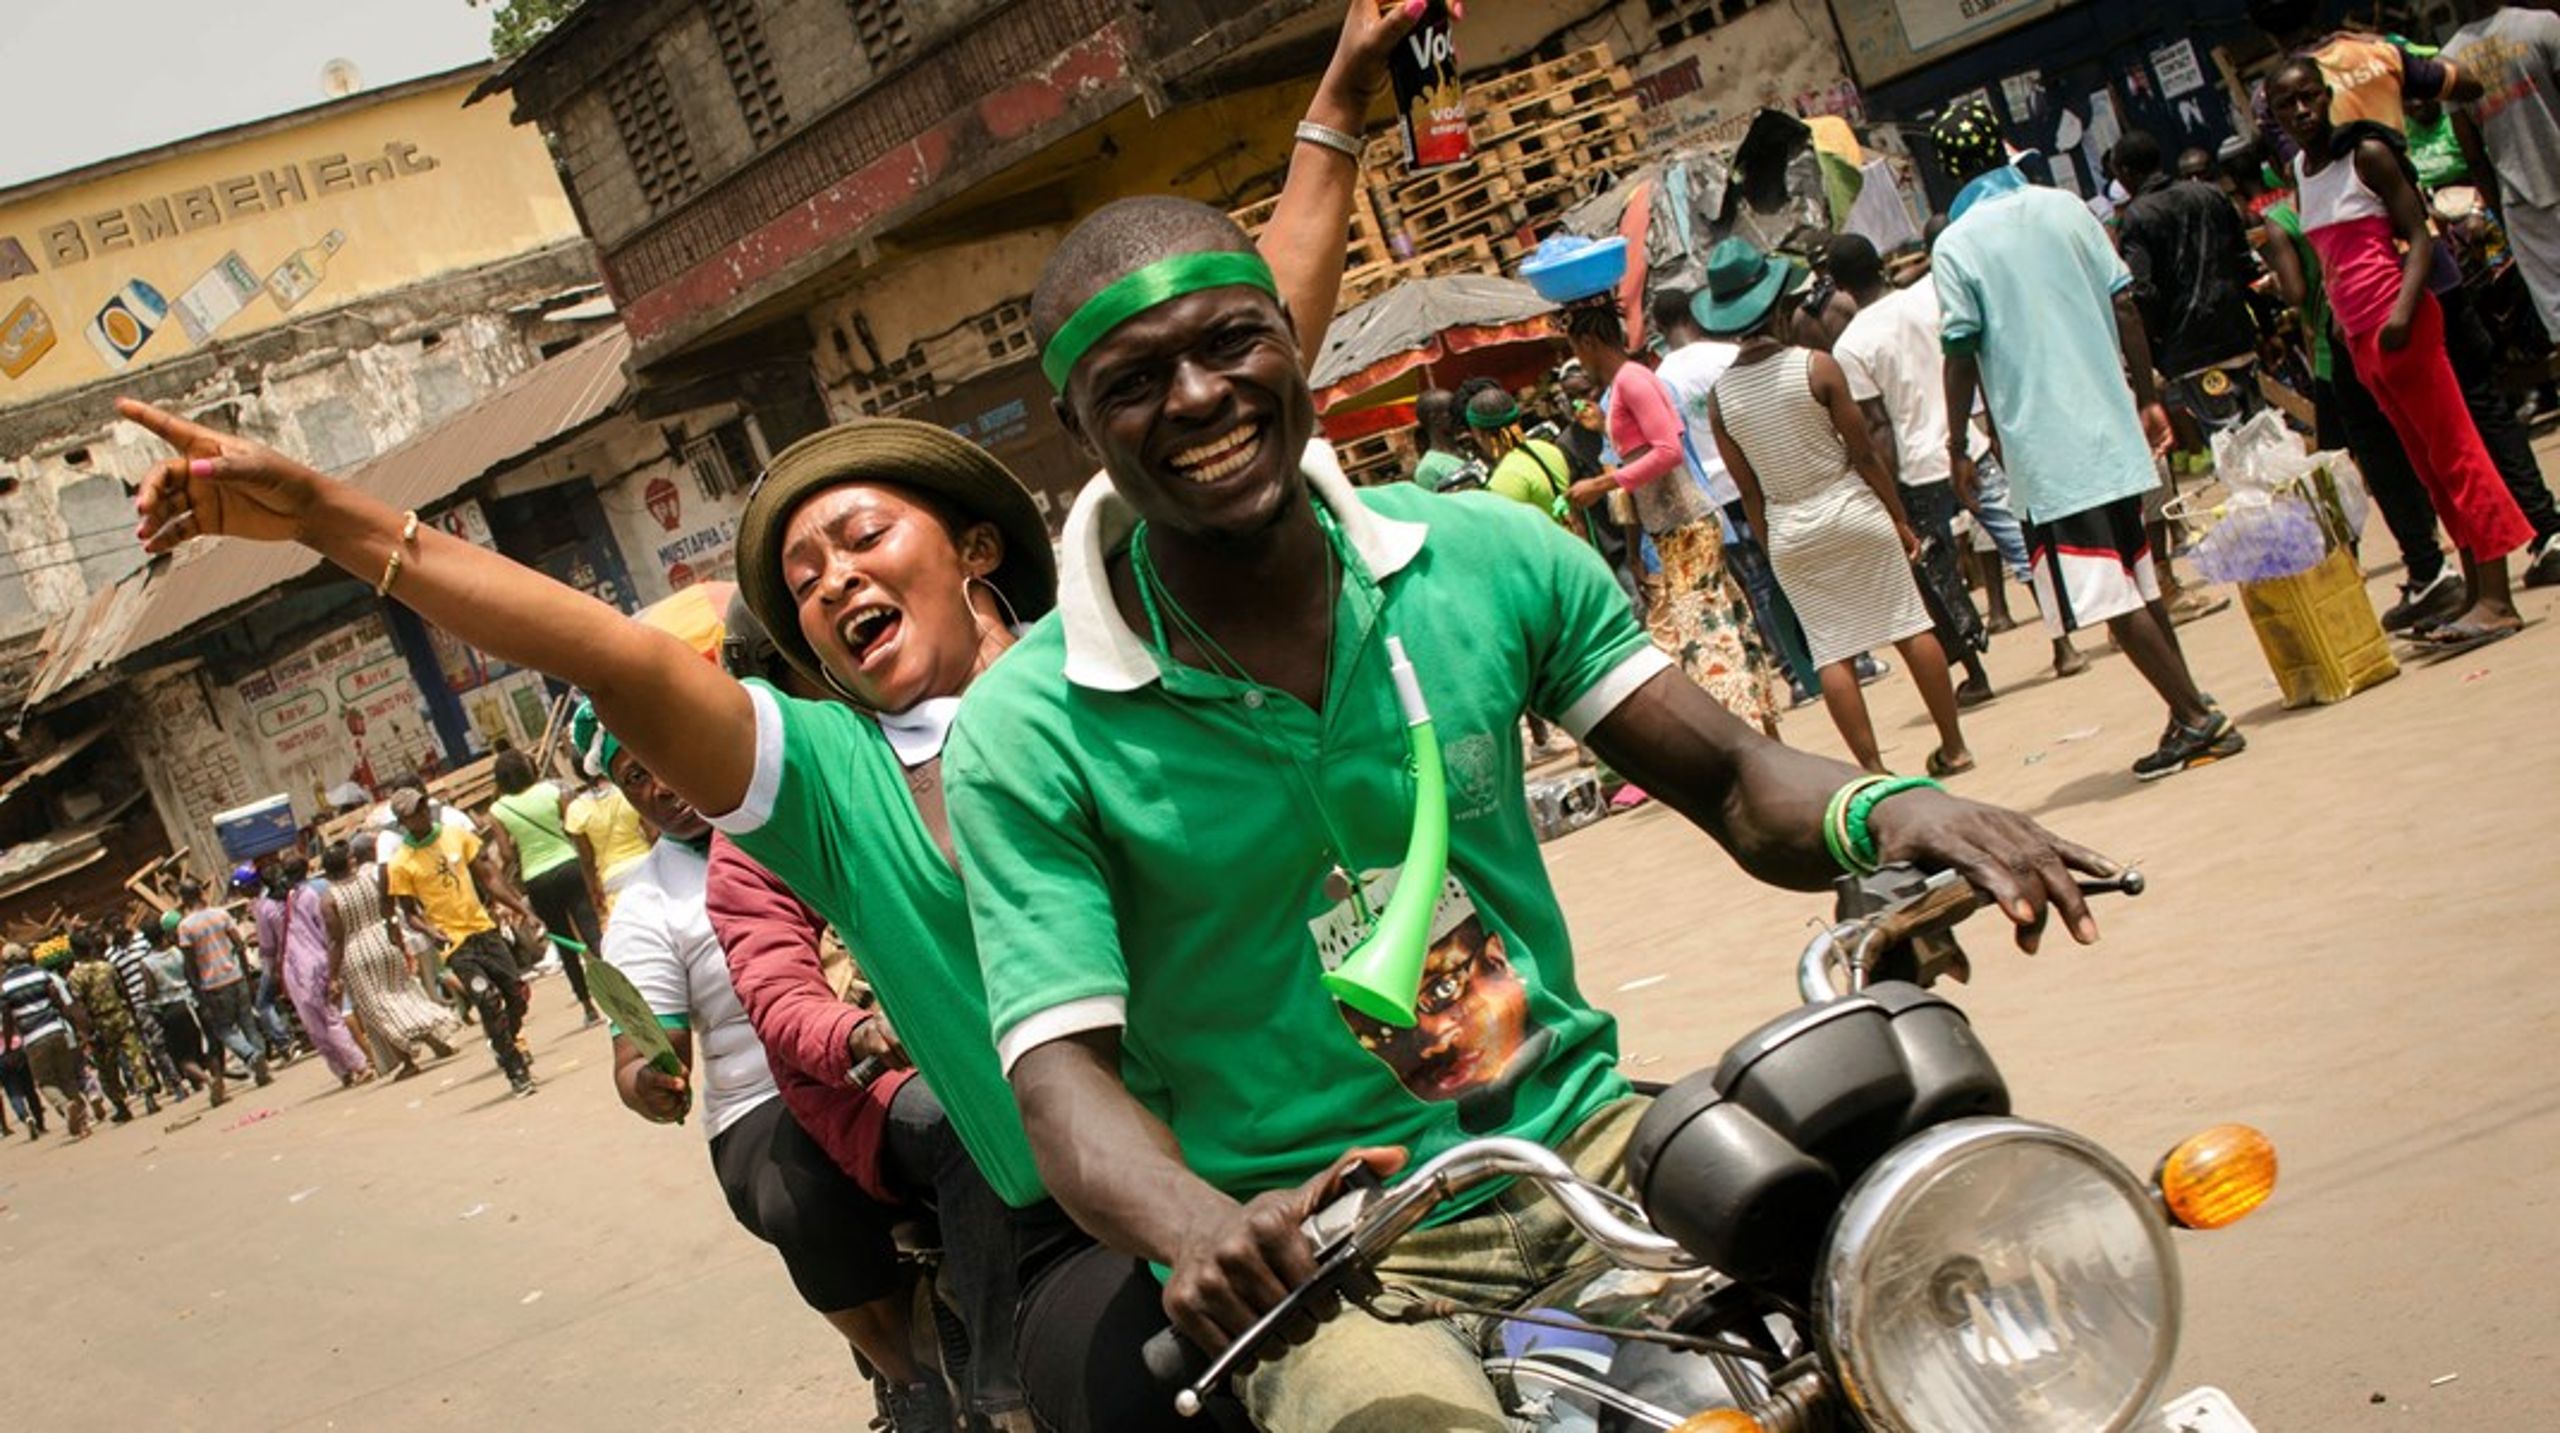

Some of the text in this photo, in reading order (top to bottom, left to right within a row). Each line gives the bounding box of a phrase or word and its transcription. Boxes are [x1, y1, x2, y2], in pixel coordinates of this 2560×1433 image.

[38, 163, 309, 269] BEMBEH
[307, 141, 441, 192] Ent.
[657, 527, 722, 567] MUSTAPHA
